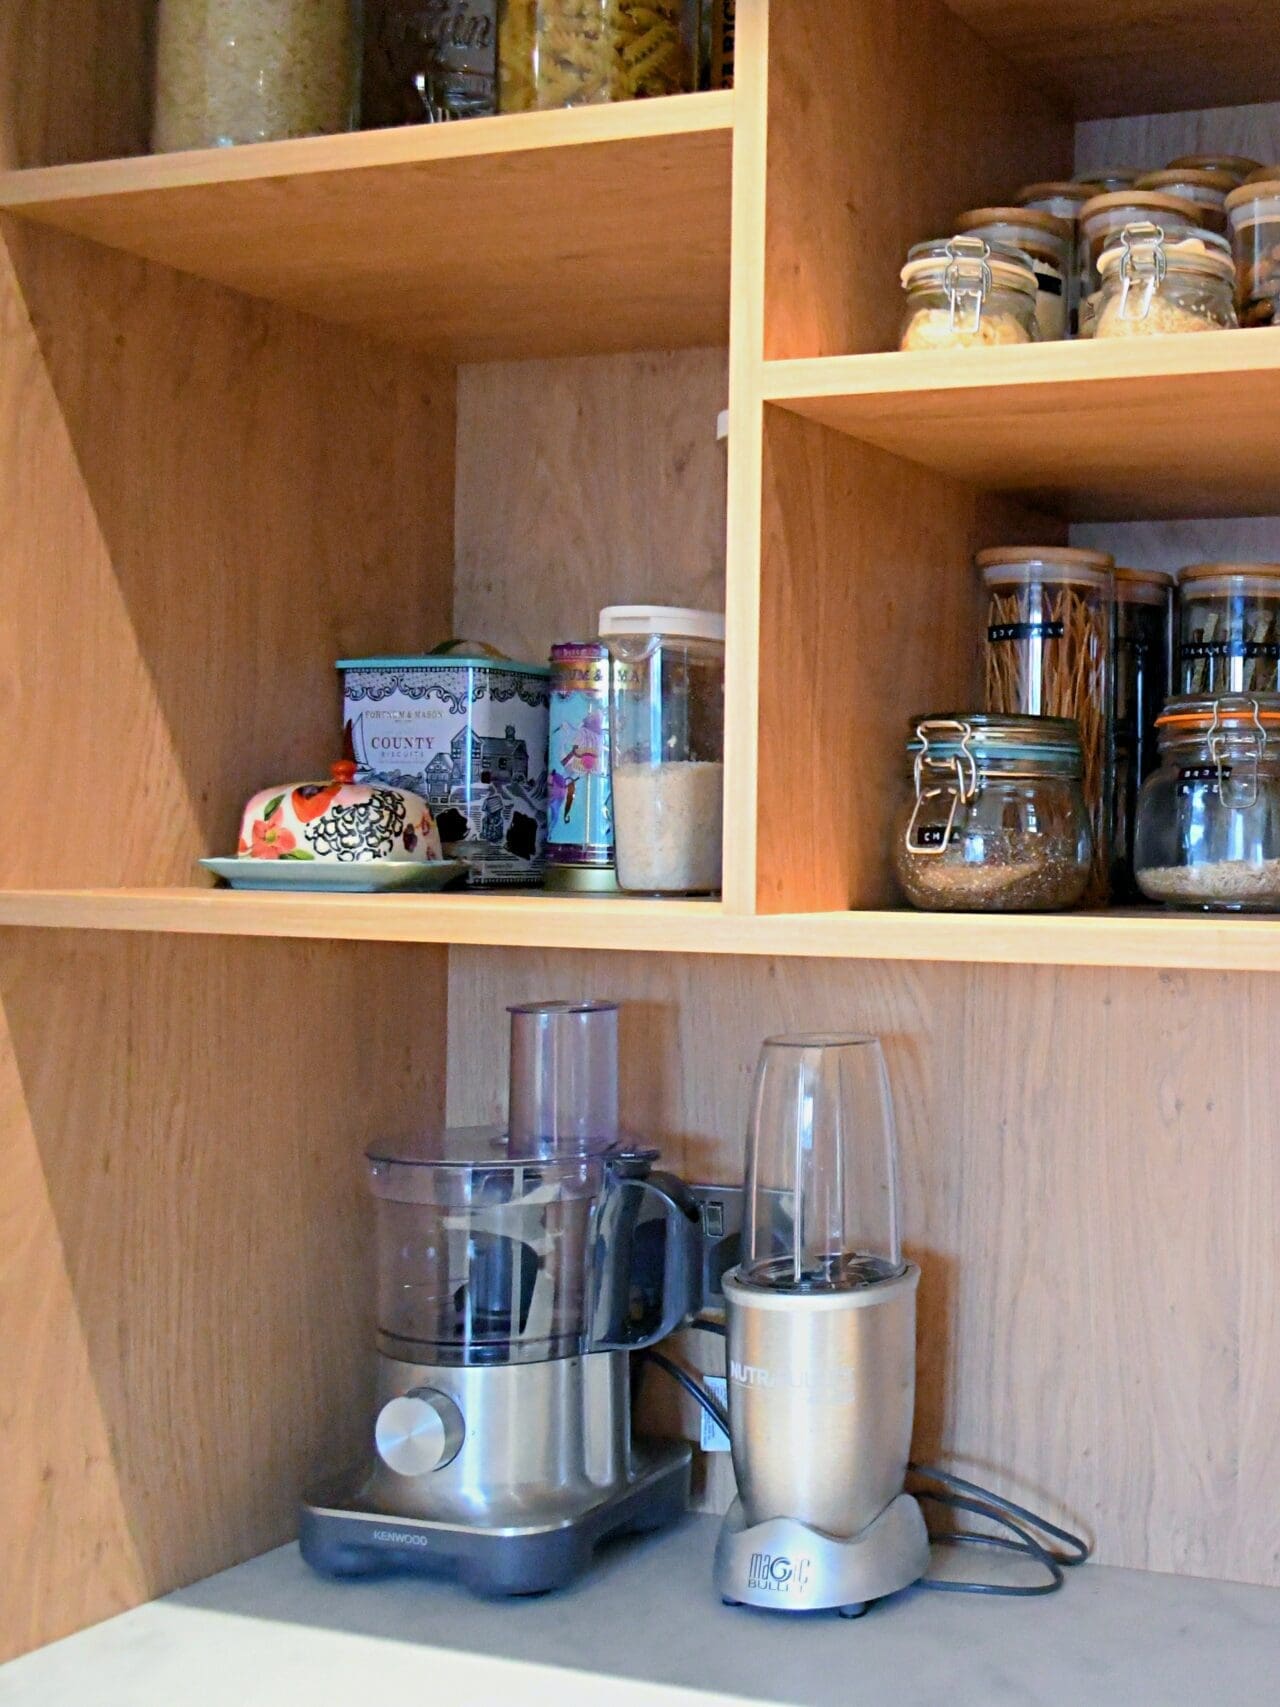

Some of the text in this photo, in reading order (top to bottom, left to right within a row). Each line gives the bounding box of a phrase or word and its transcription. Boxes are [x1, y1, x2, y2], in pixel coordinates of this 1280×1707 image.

[371, 736, 435, 750] COUNTY
[1182, 784, 1219, 794] RCE
[924, 831, 960, 842] CHA
[373, 1530, 428, 1546] KENWOOD
